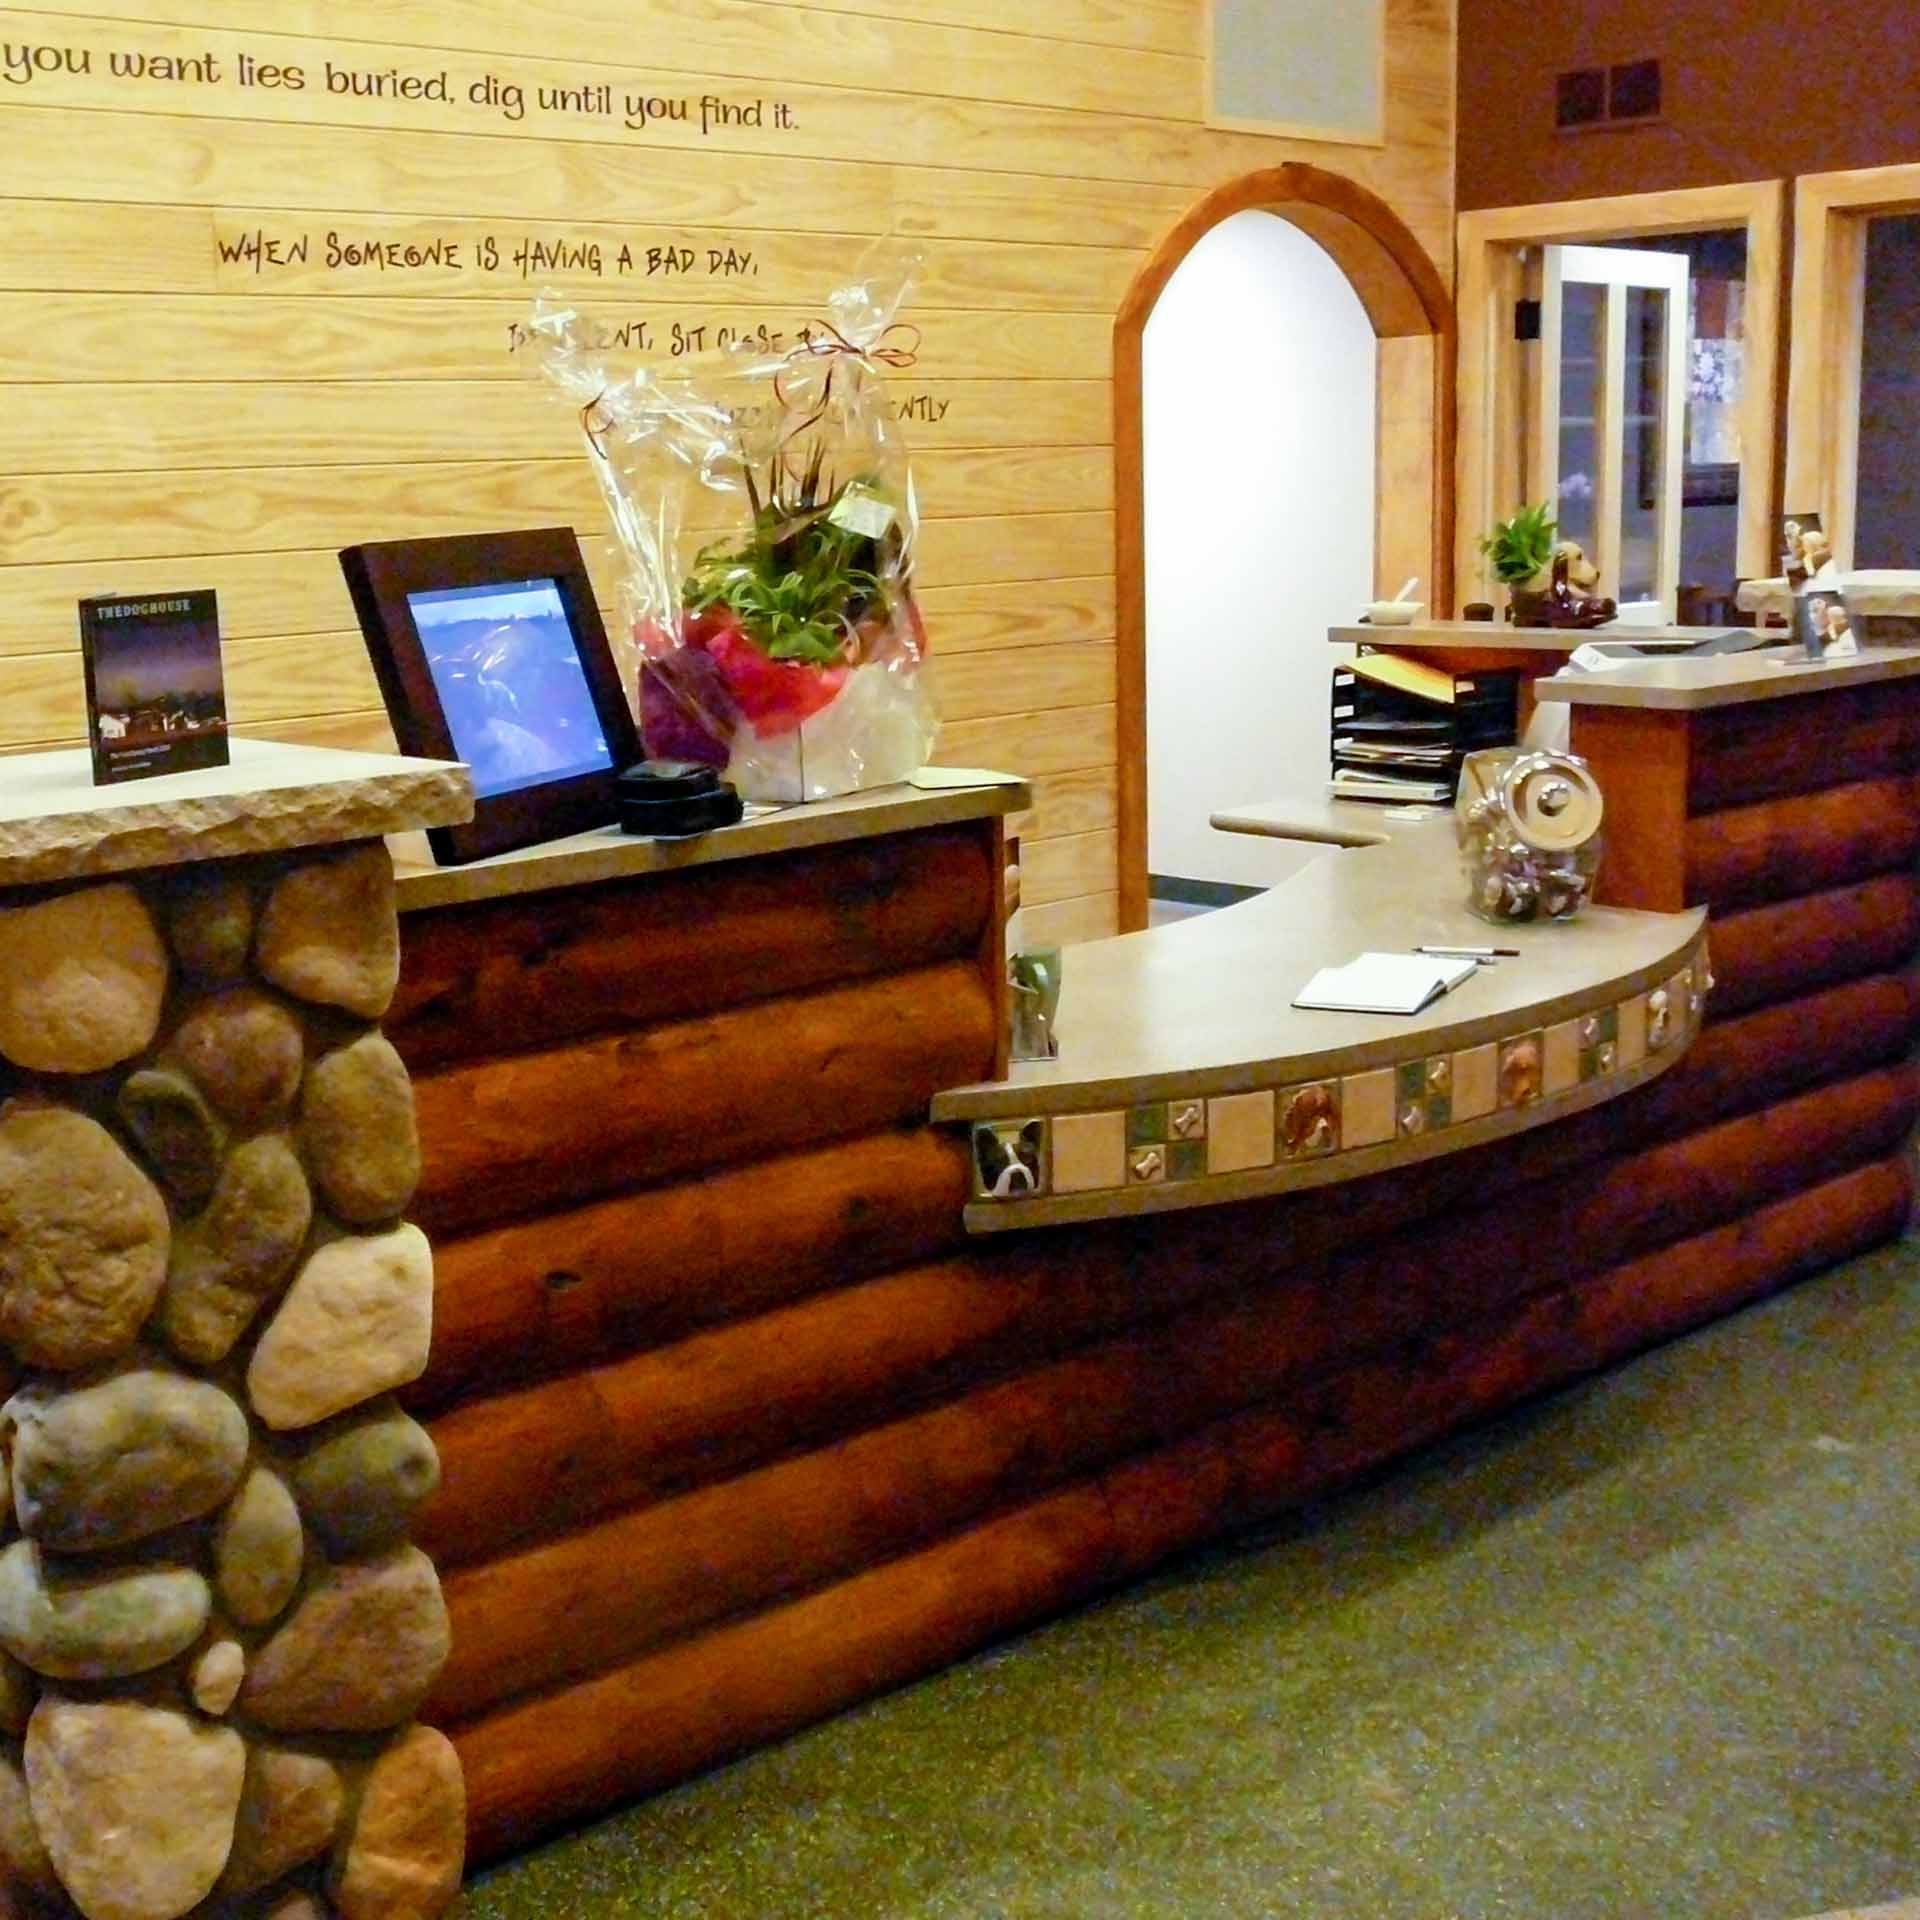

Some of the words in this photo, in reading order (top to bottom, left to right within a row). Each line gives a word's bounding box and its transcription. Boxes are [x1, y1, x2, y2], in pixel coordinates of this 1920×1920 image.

[2, 42, 91, 84] you
[110, 52, 222, 84] want
[238, 53, 306, 91] lies
[468, 74, 526, 121] dig
[538, 85, 611, 115] until
[625, 94, 688, 130] you
[700, 94, 763, 135] find
[774, 102, 800, 130] it.
[218, 229, 309, 274] WHEN
[325, 231, 463, 272] SOMEONE
[475, 235, 499, 272] IS
[513, 236, 602, 280] HAVING
[616, 246, 634, 275] A
[646, 245, 695, 276] BAD
[707, 247, 759, 277] DAY,
[670, 322, 707, 357] SIT
